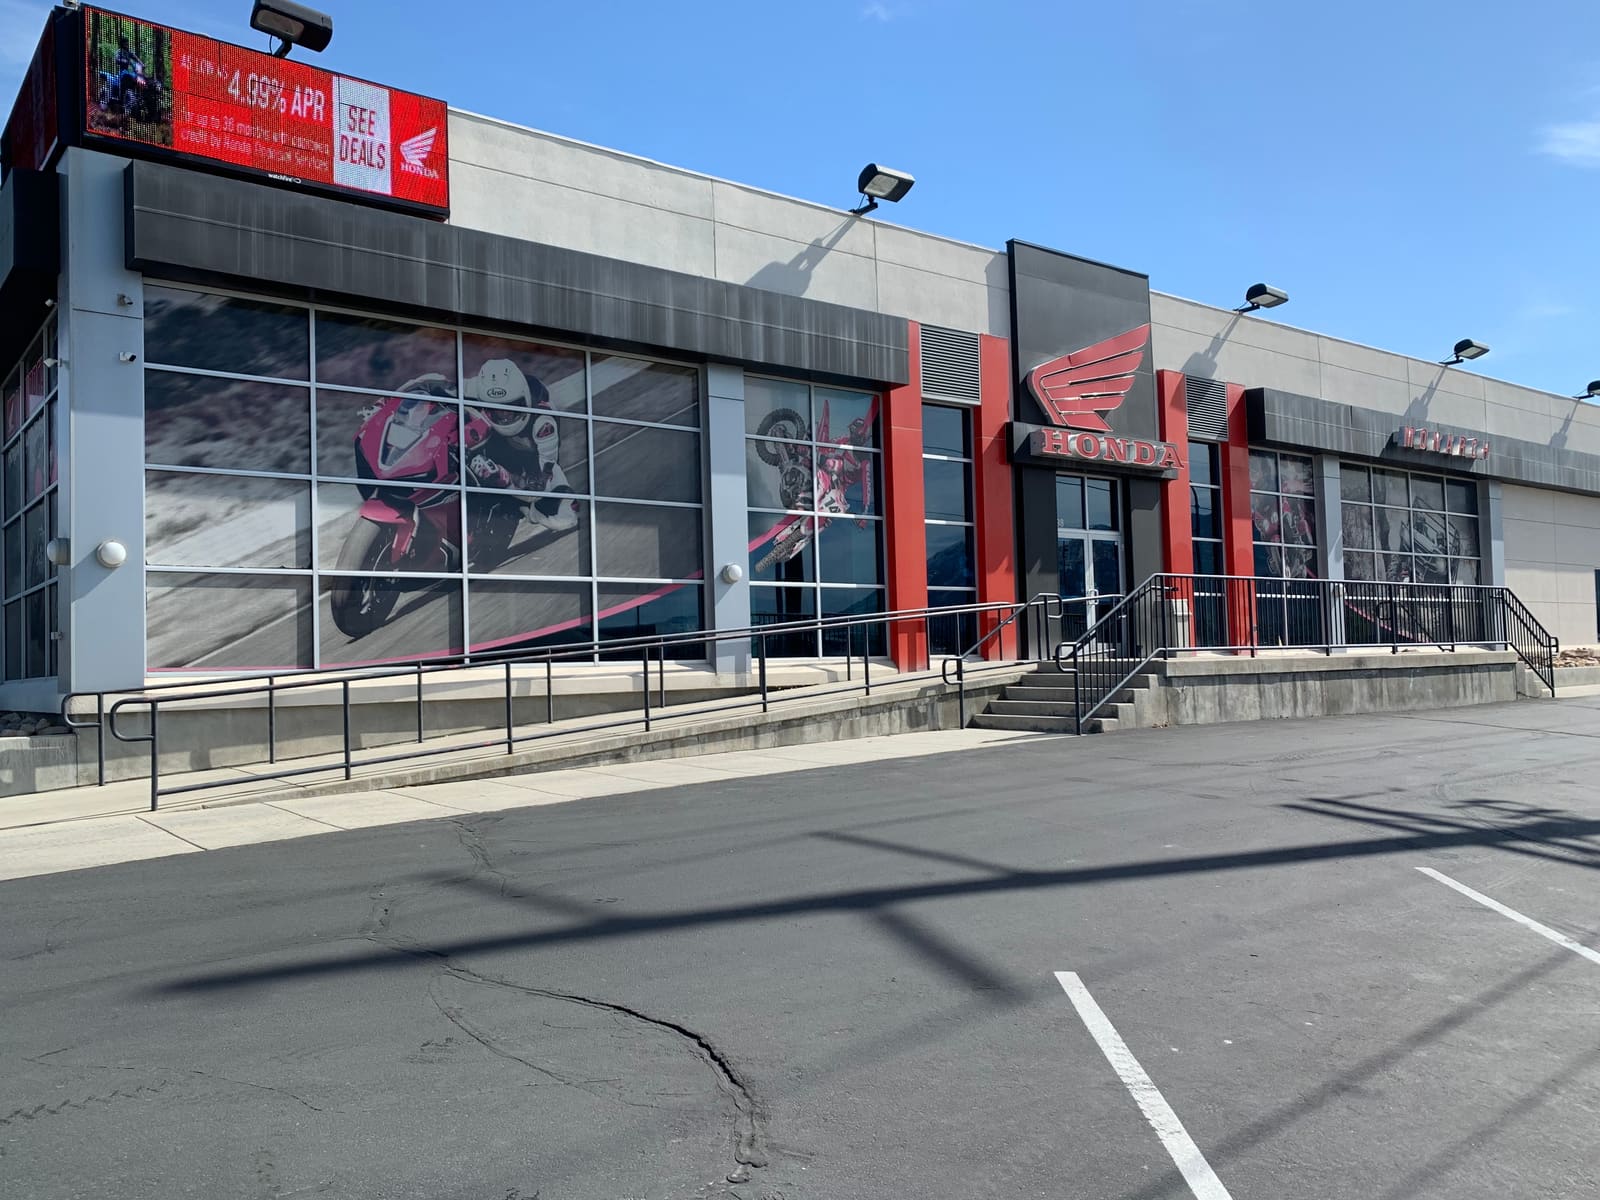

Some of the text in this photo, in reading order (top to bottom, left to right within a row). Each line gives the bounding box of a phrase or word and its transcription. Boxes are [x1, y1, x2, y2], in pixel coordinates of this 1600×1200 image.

[291, 85, 325, 122] APR
[348, 105, 376, 136] SEE
[340, 134, 386, 170] DEALS
[401, 162, 439, 179] HONDA
[1042, 428, 1184, 469] HONDA
